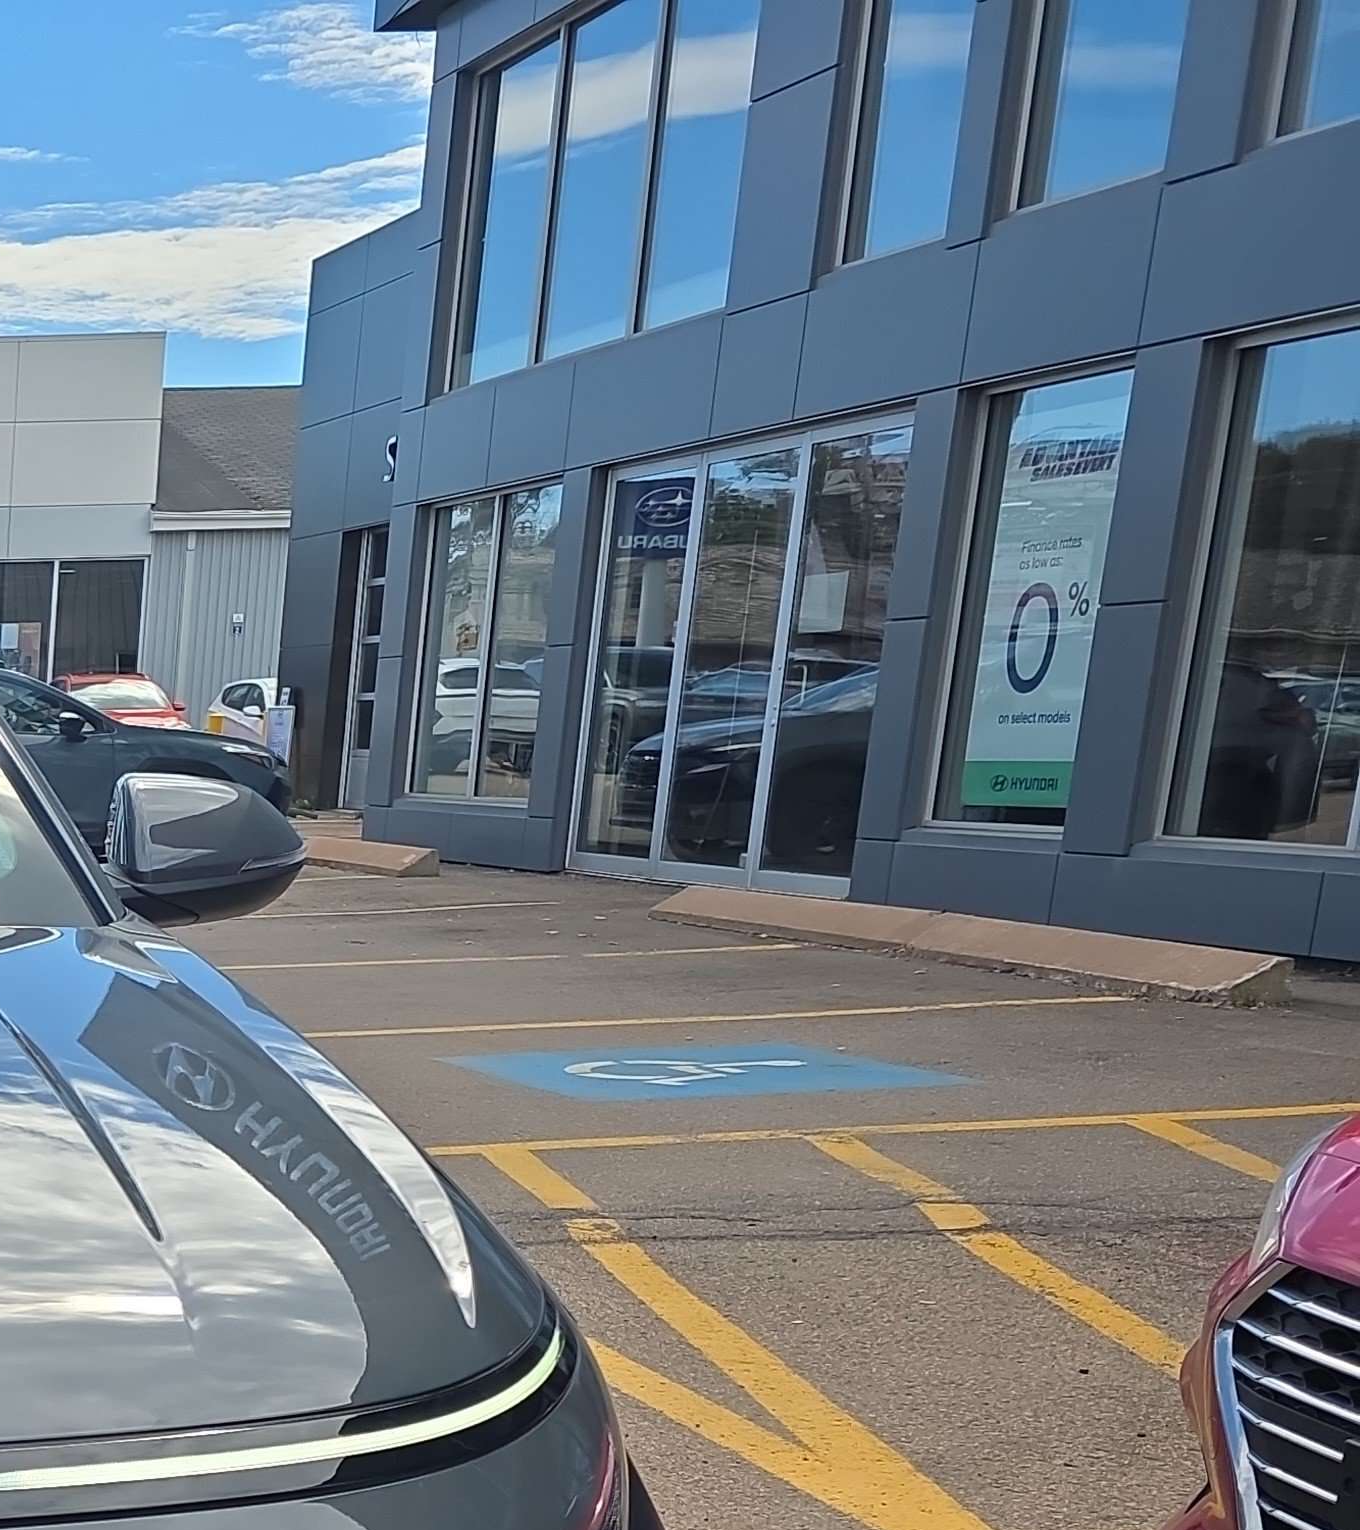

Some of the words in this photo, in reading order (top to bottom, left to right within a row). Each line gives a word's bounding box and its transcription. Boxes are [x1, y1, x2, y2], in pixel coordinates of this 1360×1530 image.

[1021, 540, 1058, 553] Finance
[1060, 537, 1082, 549] rates
[1019, 561, 1030, 570] as
[1032, 558, 1047, 569] low
[998, 714, 1009, 724] on
[1011, 712, 1037, 724] select
[1038, 711, 1071, 724] models
[1010, 777, 1058, 791] HYUNDAI
